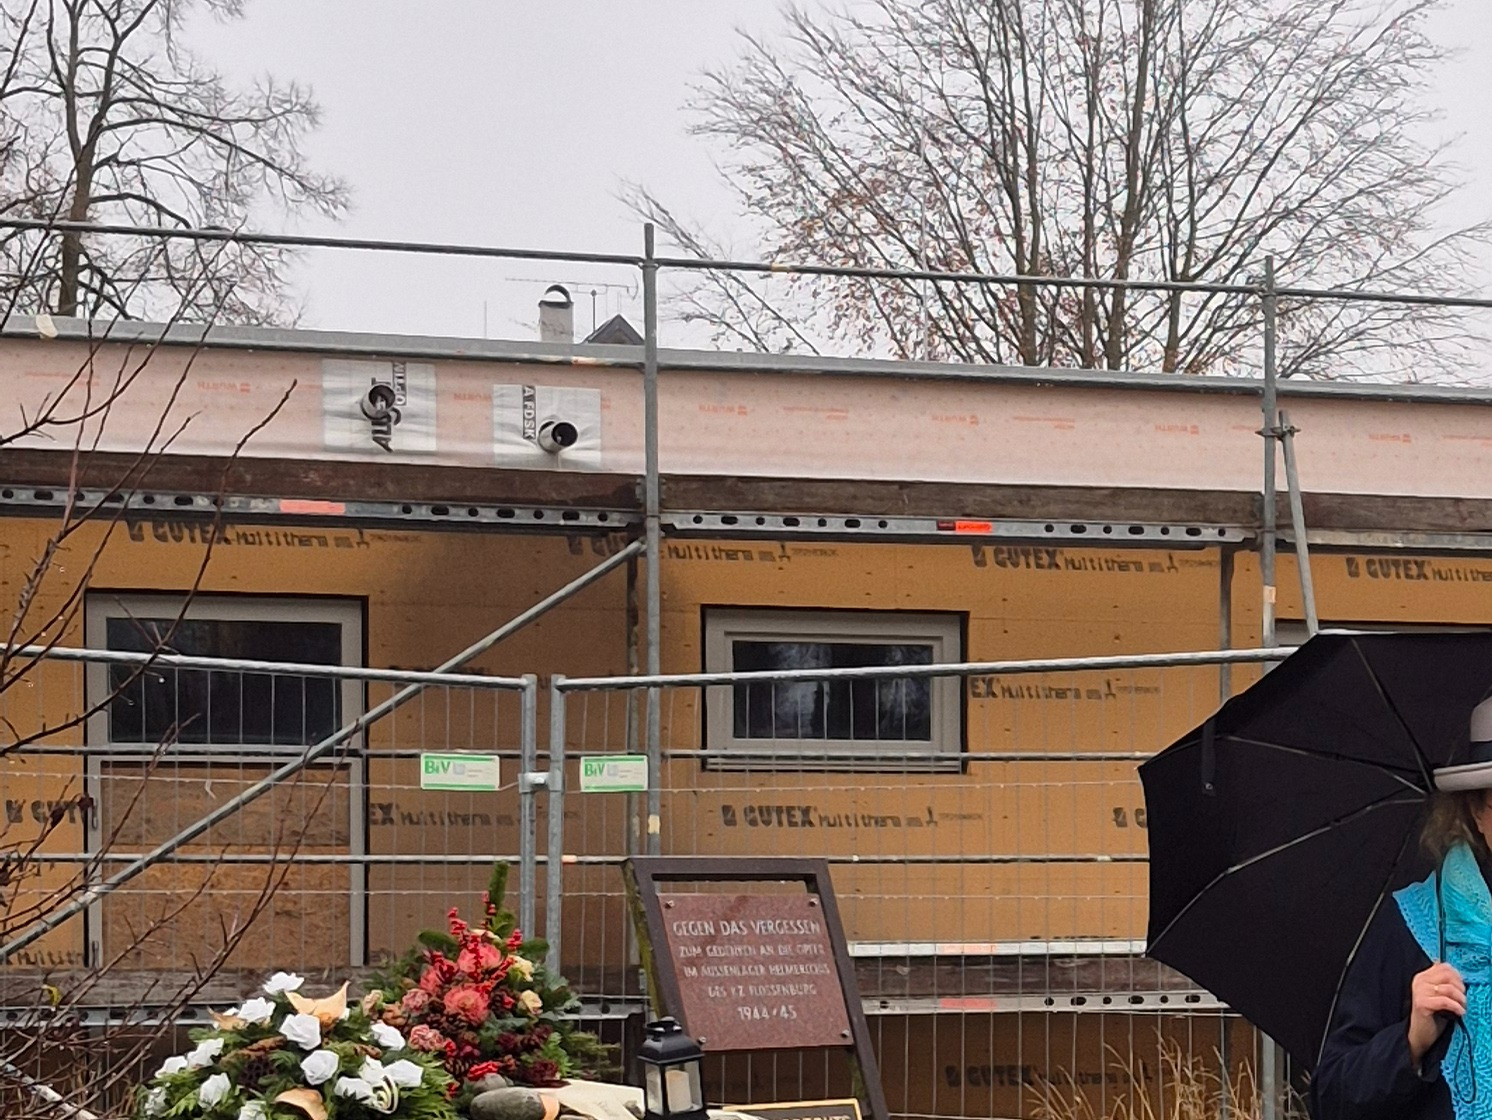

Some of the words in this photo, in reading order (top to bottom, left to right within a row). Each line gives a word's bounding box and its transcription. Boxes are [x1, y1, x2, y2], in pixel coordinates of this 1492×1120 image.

[1366, 558, 1430, 581] GUTEX
[743, 804, 816, 828] GUTEX
[672, 920, 715, 937] GEGEN
[720, 919, 748, 936] DAS
[750, 918, 821, 935] VERGESSEN
